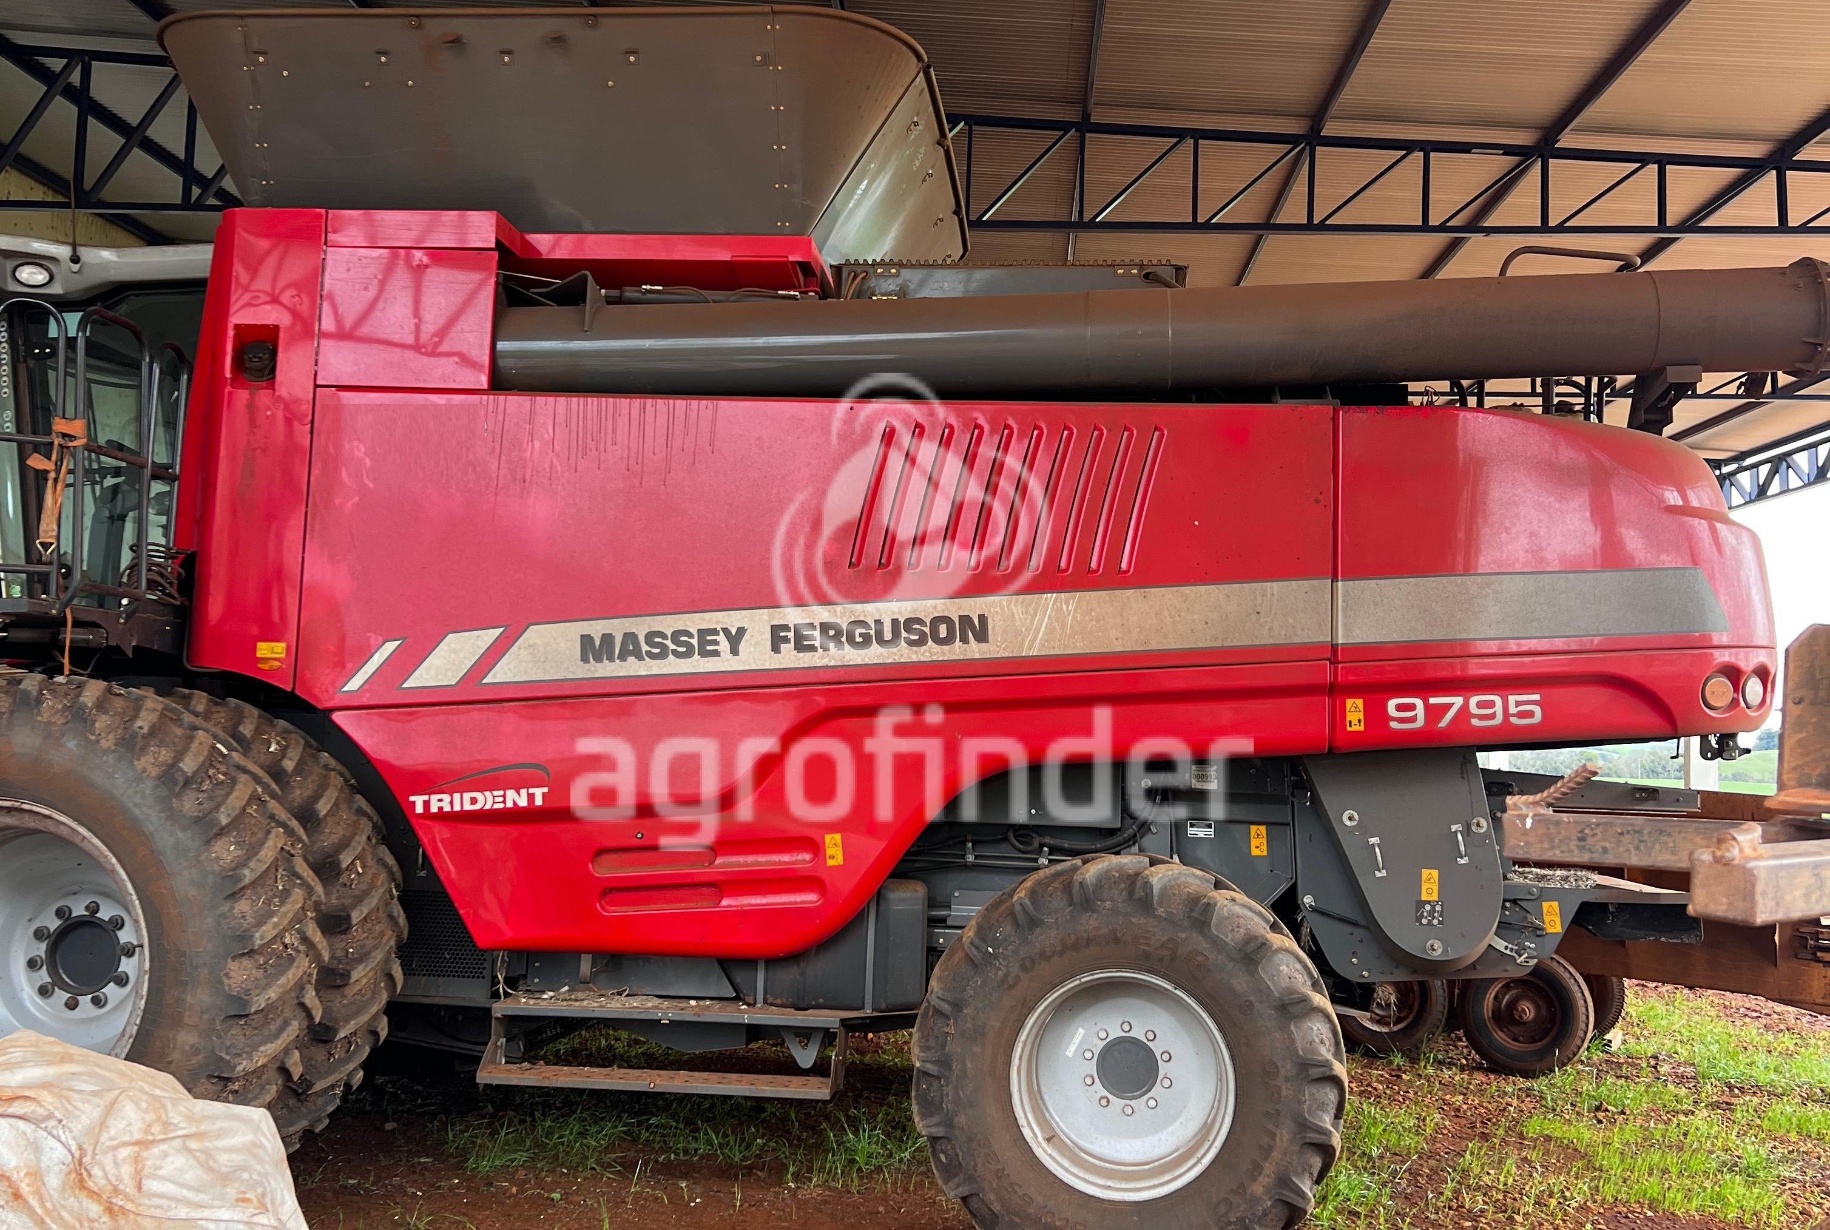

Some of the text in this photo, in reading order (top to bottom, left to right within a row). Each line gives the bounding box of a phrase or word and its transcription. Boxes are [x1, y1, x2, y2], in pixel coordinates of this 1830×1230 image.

[580, 613, 990, 664] MASSEY FERGUSON
[1387, 693, 1543, 730] 9795
[408, 786, 549, 814] TRIDENT
